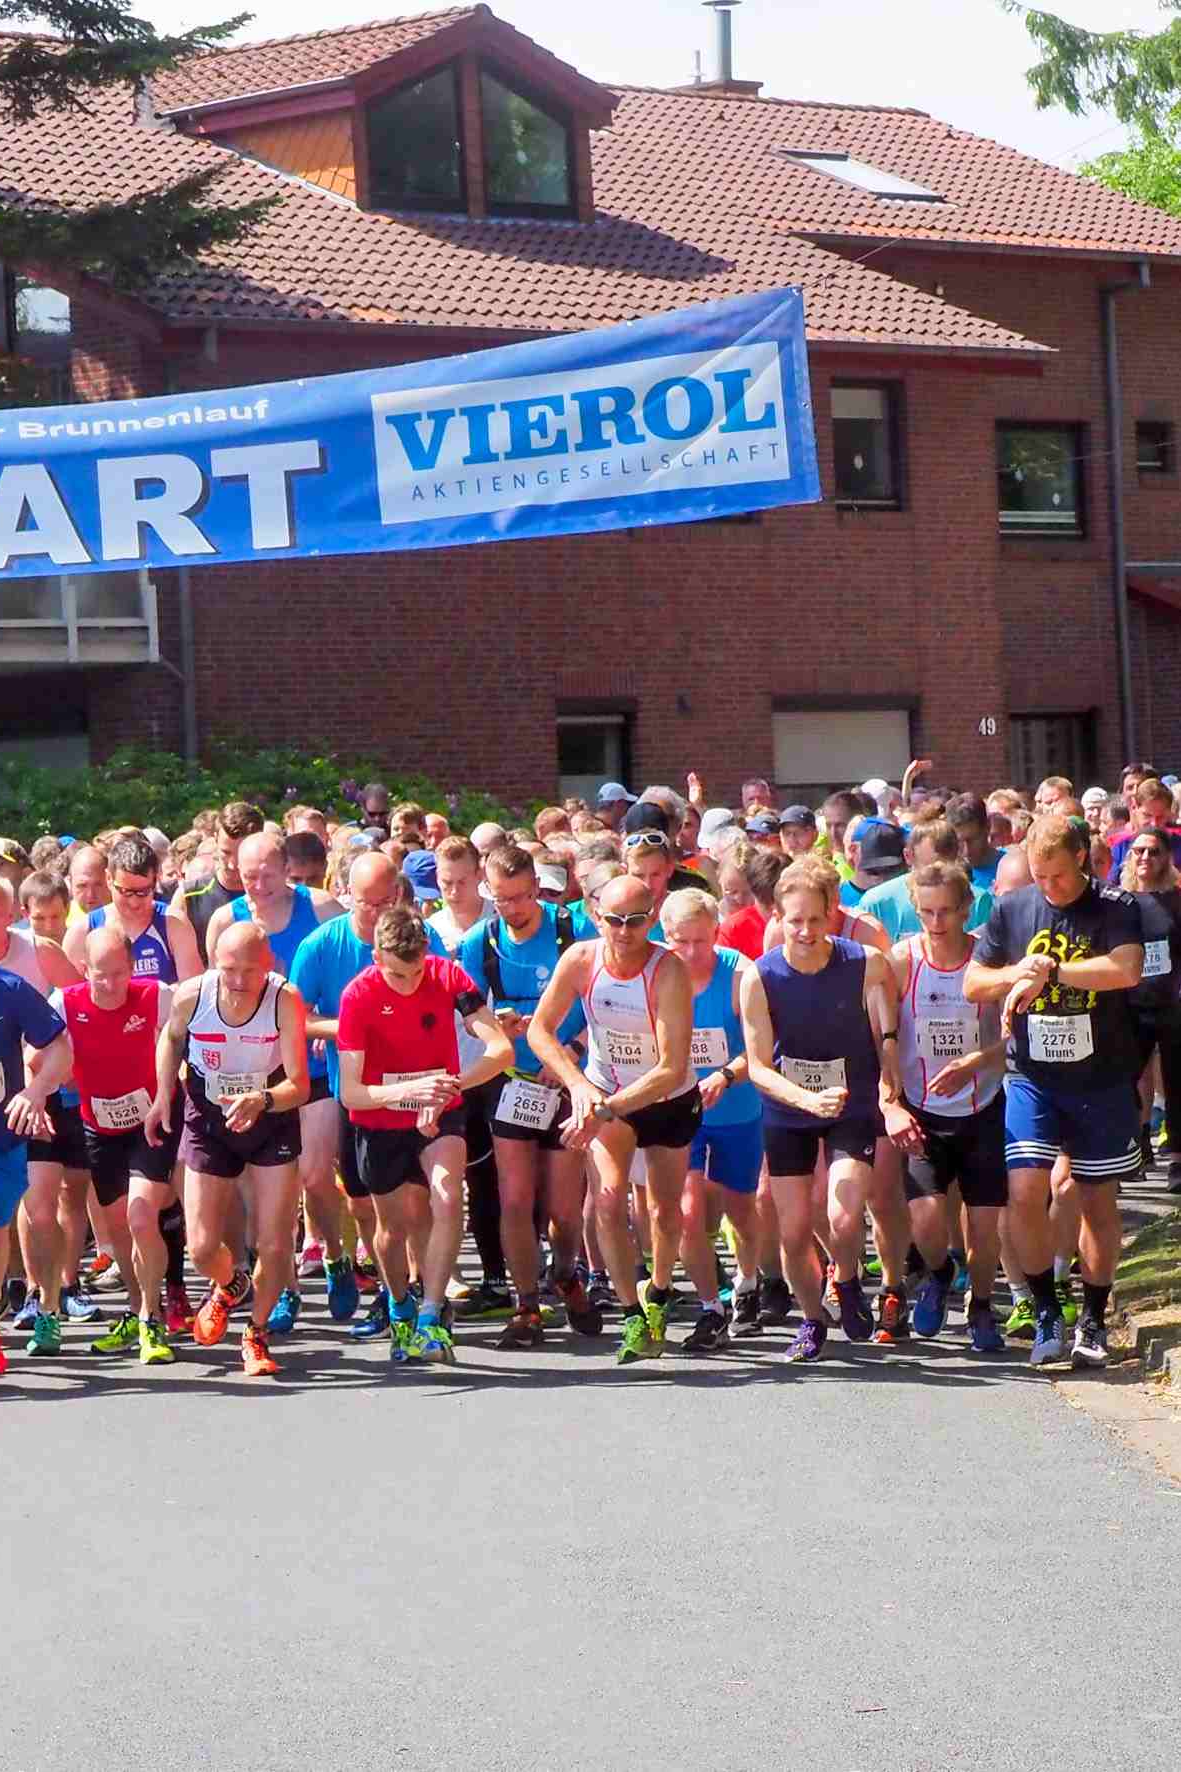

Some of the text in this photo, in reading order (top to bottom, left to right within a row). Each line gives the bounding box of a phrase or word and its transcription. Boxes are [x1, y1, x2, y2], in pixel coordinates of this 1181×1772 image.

[18, 400, 269, 439] Brunnenlauf
[385, 368, 778, 471] VIEROL
[412, 442, 780, 501] AKTIENGESELLSCHAFT
[979, 717, 996, 736] 49
[931, 1034, 964, 1045] 1321
[1042, 1033, 1076, 1046] 2276
[608, 1043, 641, 1056] 2104
[691, 1043, 708, 1054] 88
[933, 1046, 963, 1057] bruns
[1045, 1046, 1075, 1058] bruns
[610, 1054, 641, 1065] bruns
[804, 1073, 822, 1083] 29
[219, 1086, 253, 1096] 1867
[514, 1096, 547, 1113] 2653
[107, 1105, 140, 1119] 1528
[513, 1108, 542, 1125] bruns
[111, 1116, 141, 1127] bruns
